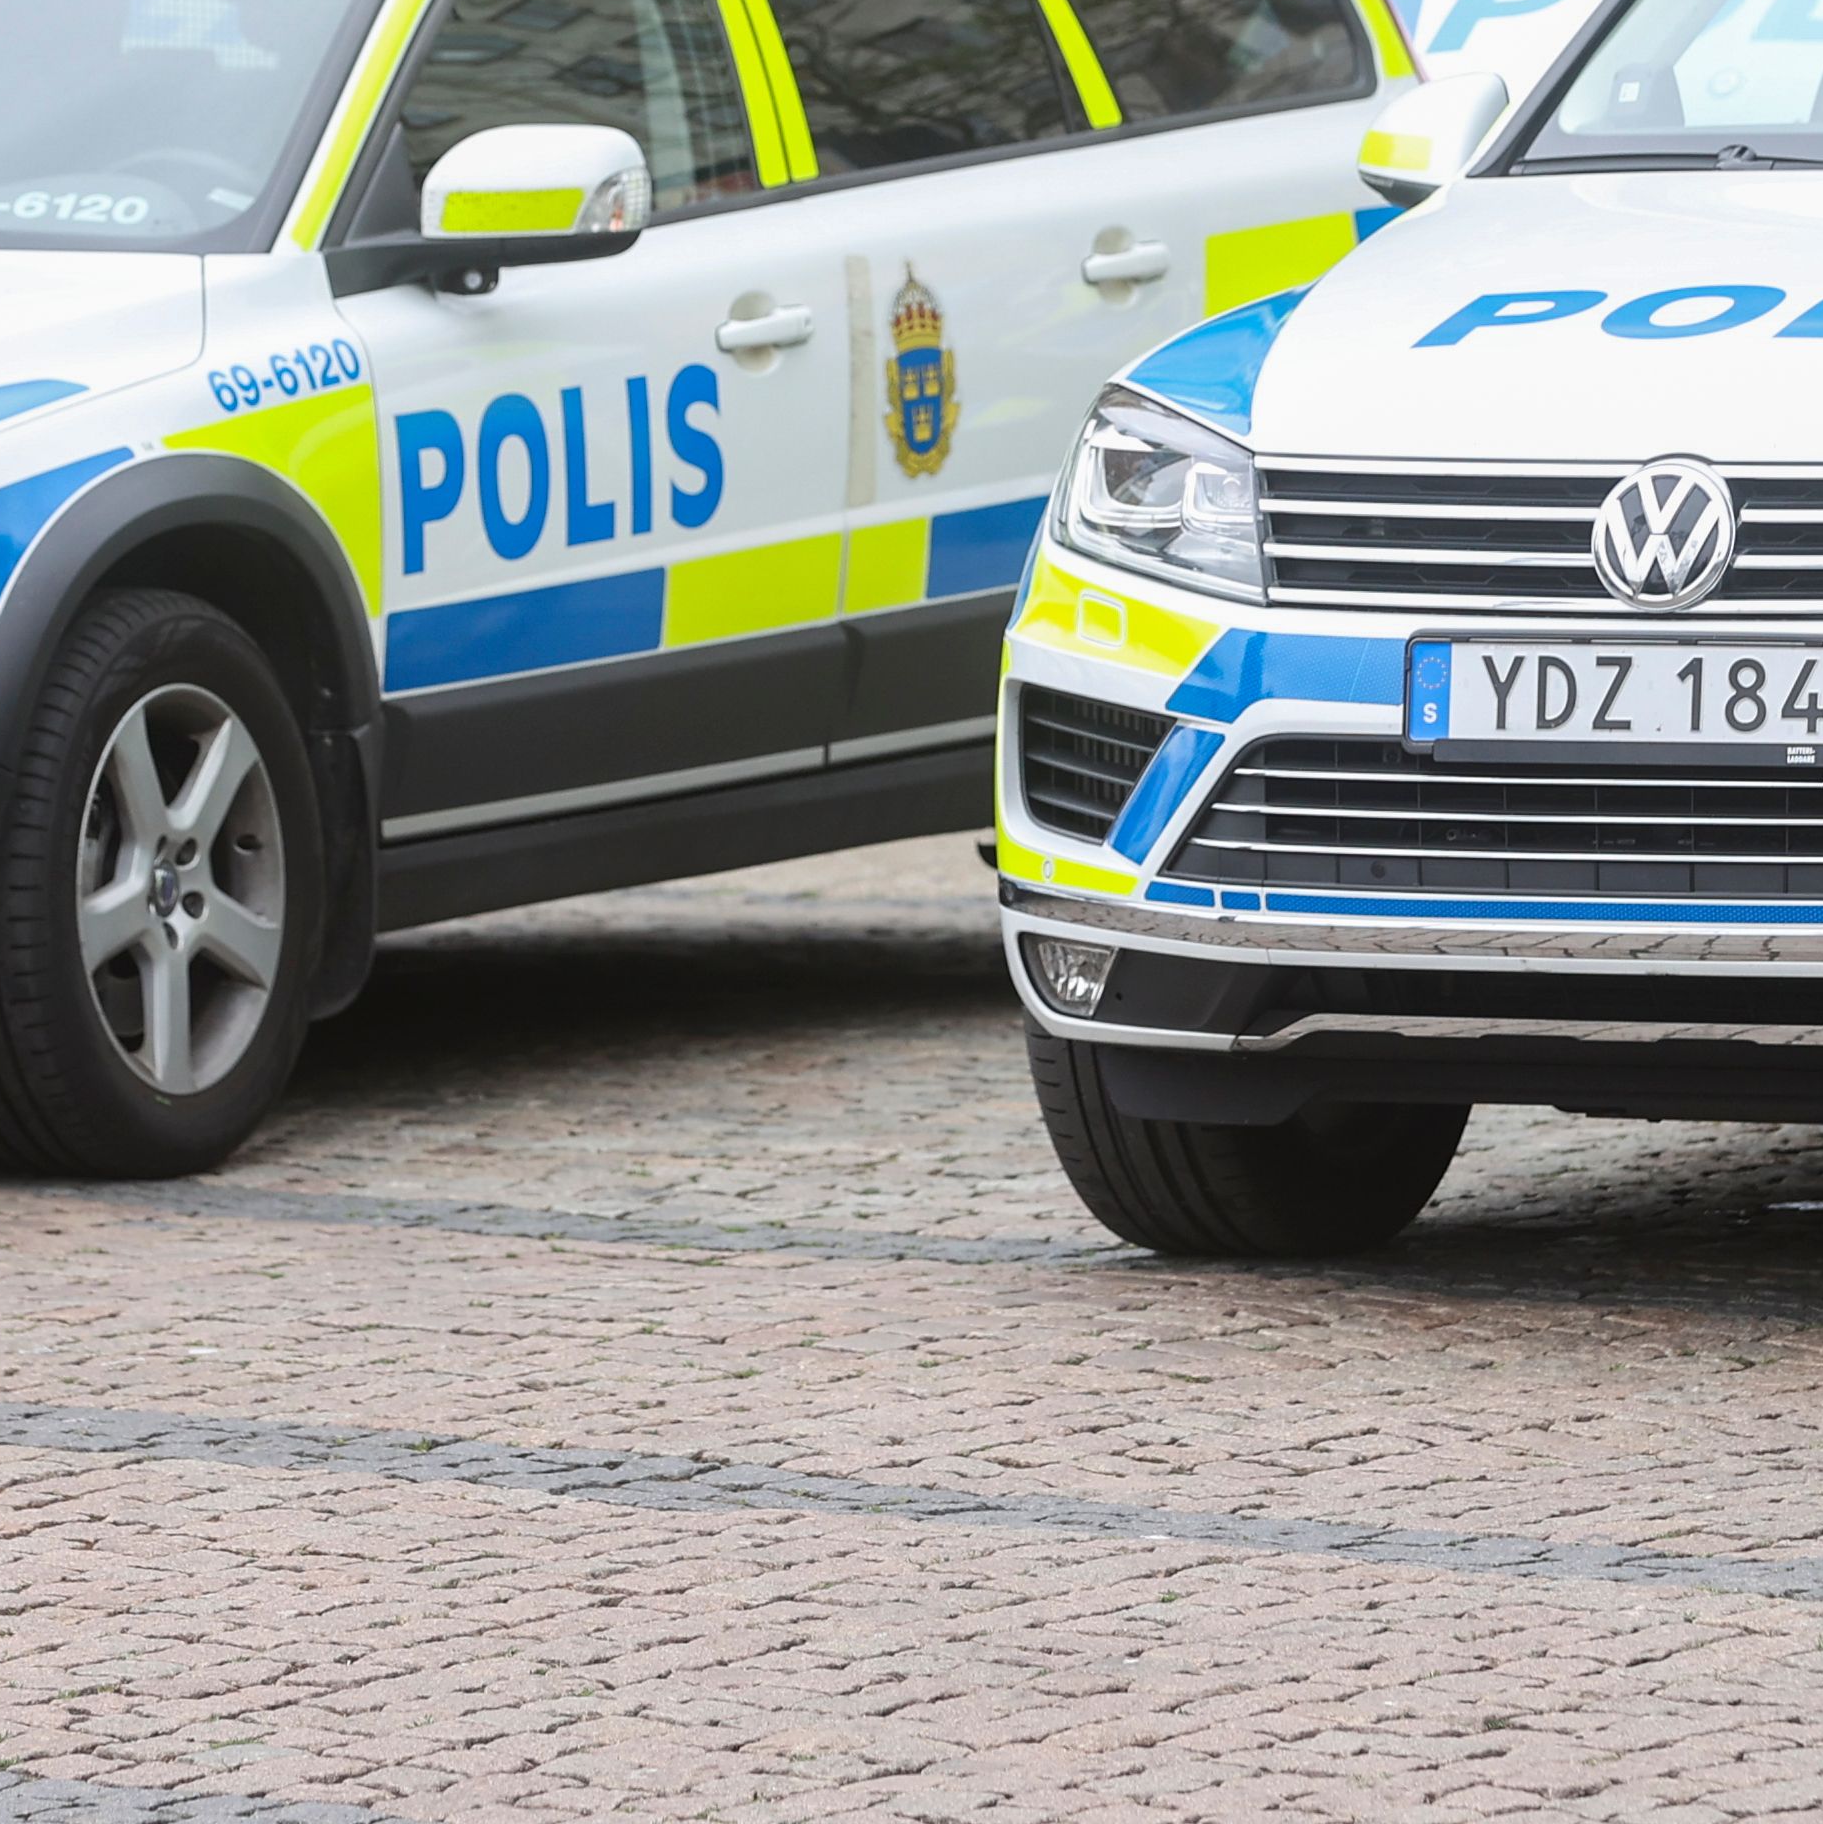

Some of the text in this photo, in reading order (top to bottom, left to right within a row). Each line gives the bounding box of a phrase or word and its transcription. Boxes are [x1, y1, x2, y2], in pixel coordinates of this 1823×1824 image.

[208, 339, 360, 412] 69-6120
[394, 364, 723, 576] POLIS
[1423, 702, 1437, 724] S
[1481, 655, 1635, 731] YDZ
